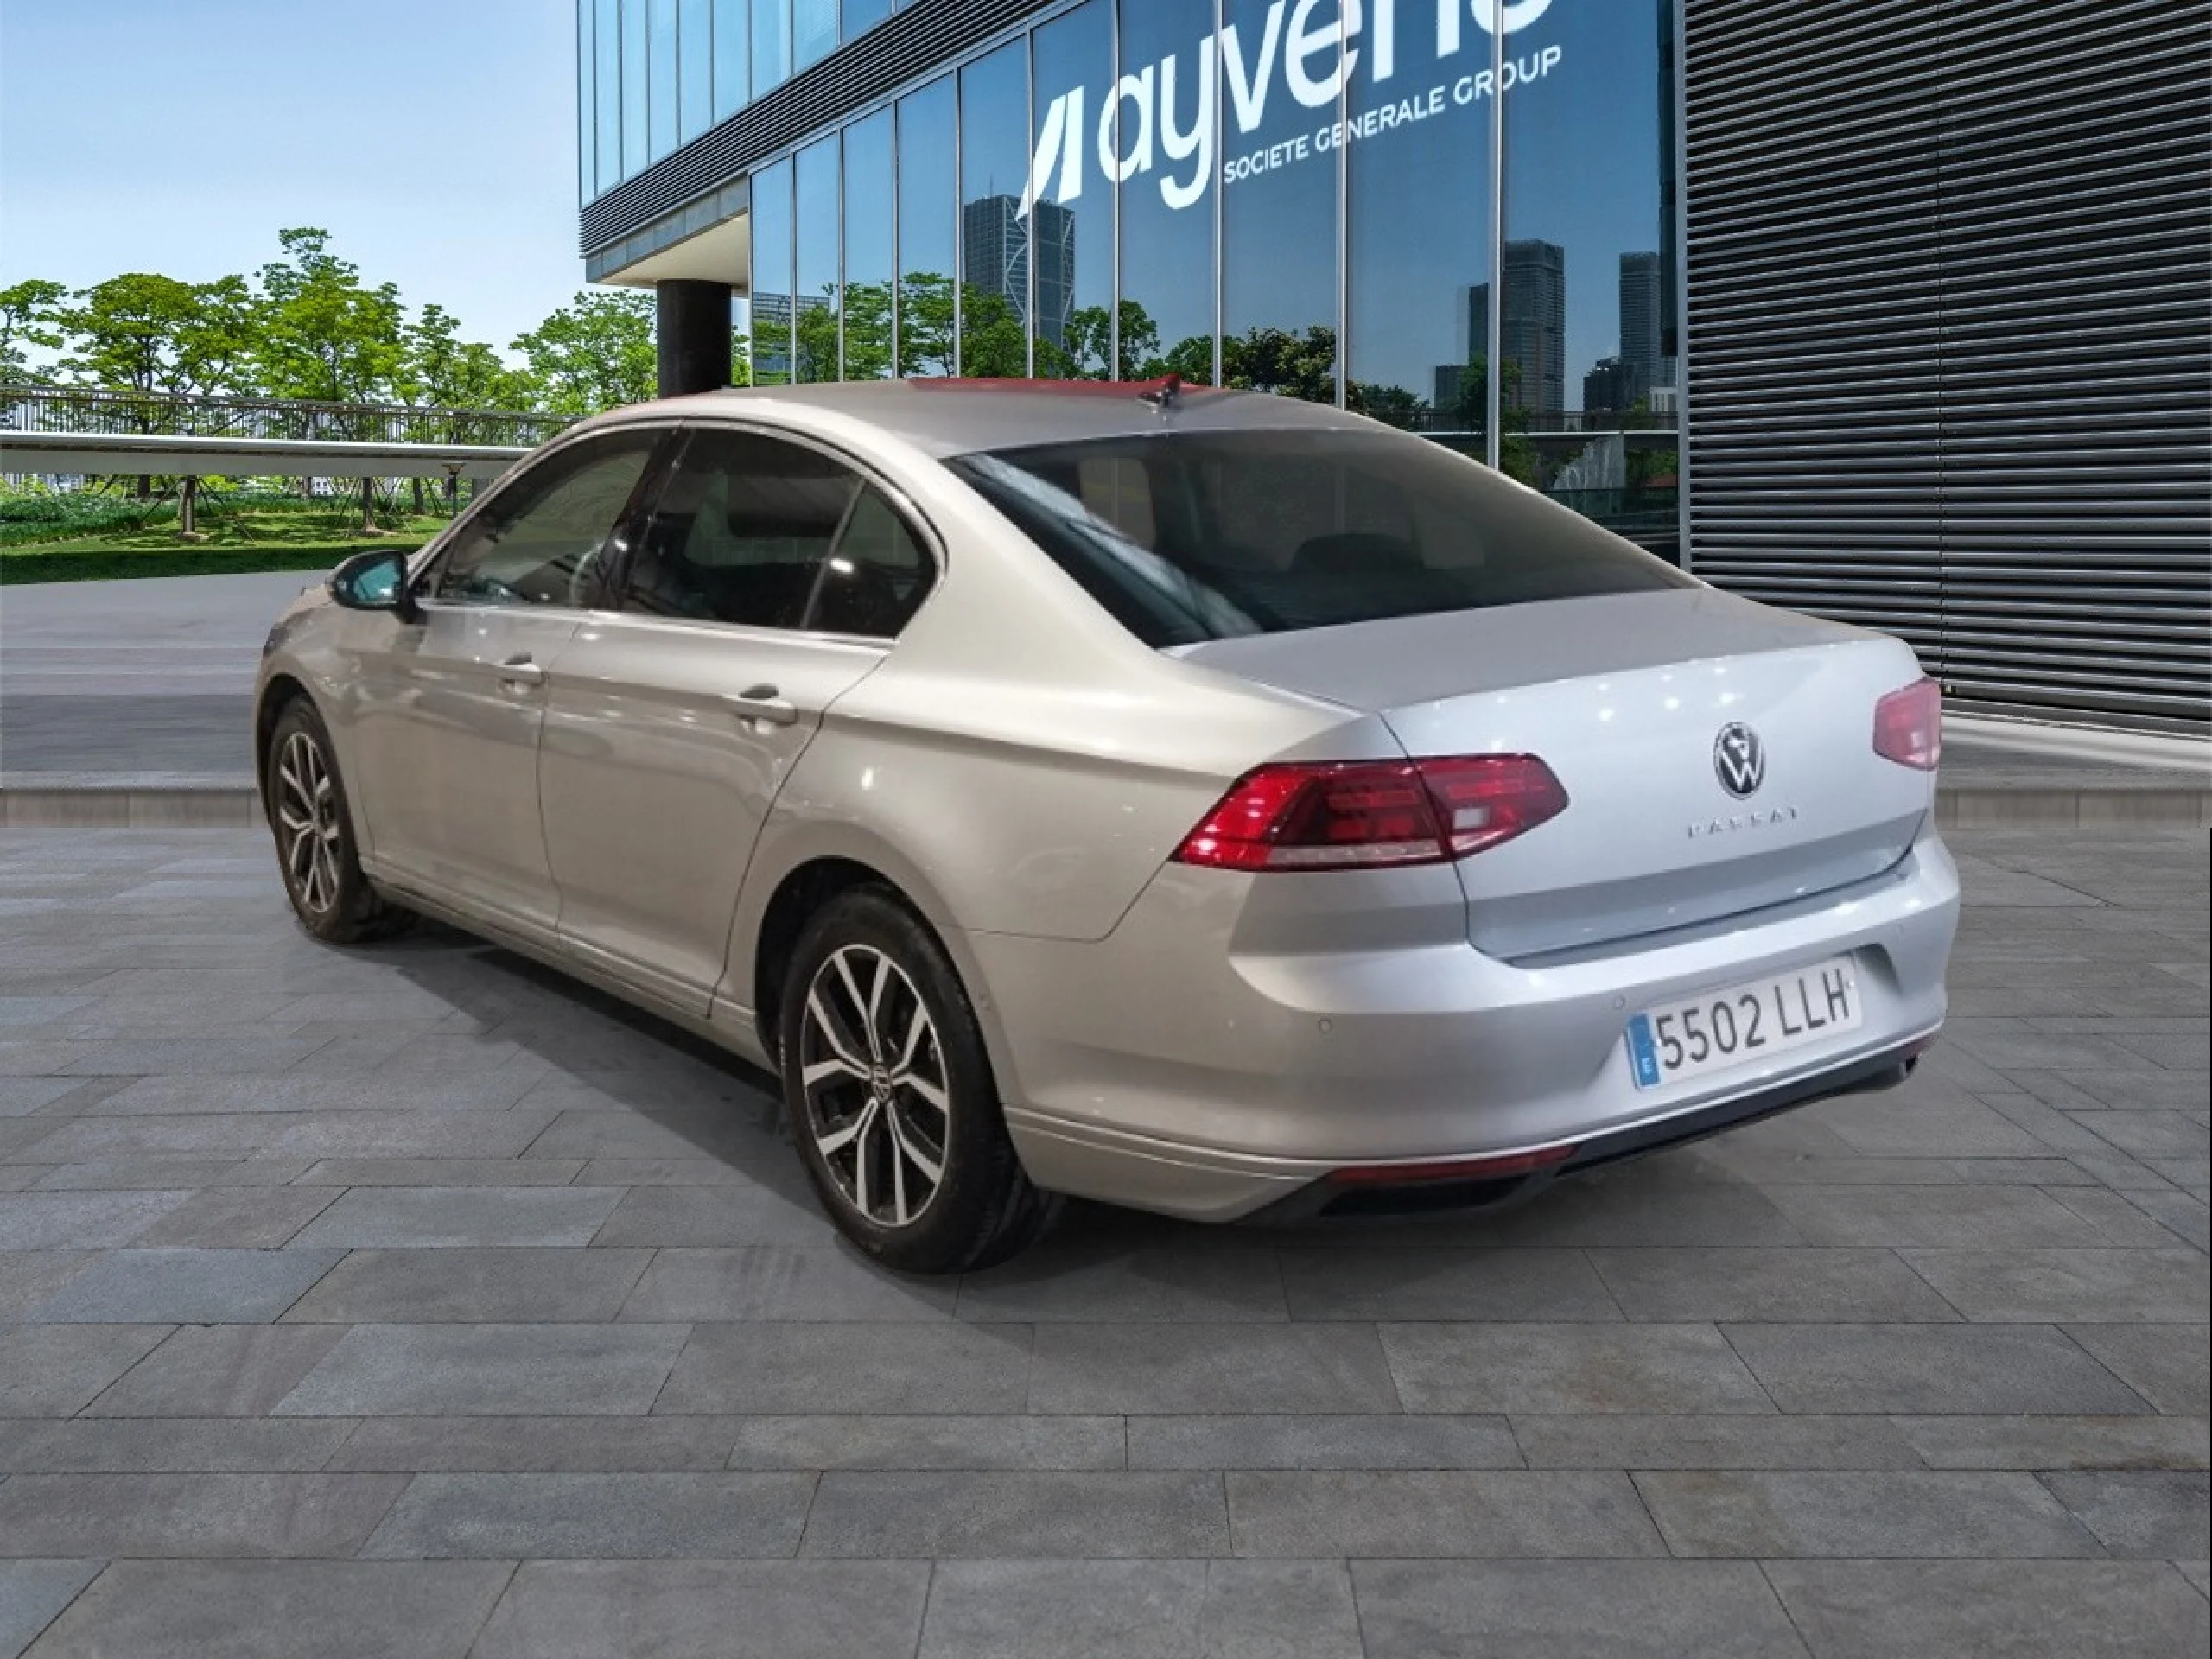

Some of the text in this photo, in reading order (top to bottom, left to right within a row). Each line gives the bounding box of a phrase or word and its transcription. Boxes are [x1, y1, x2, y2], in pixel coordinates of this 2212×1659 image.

[1224, 135, 1309, 184] SOCIETE
[1314, 86, 1446, 153] GENERALE
[1655, 969, 1851, 1070] 5502 LLH
